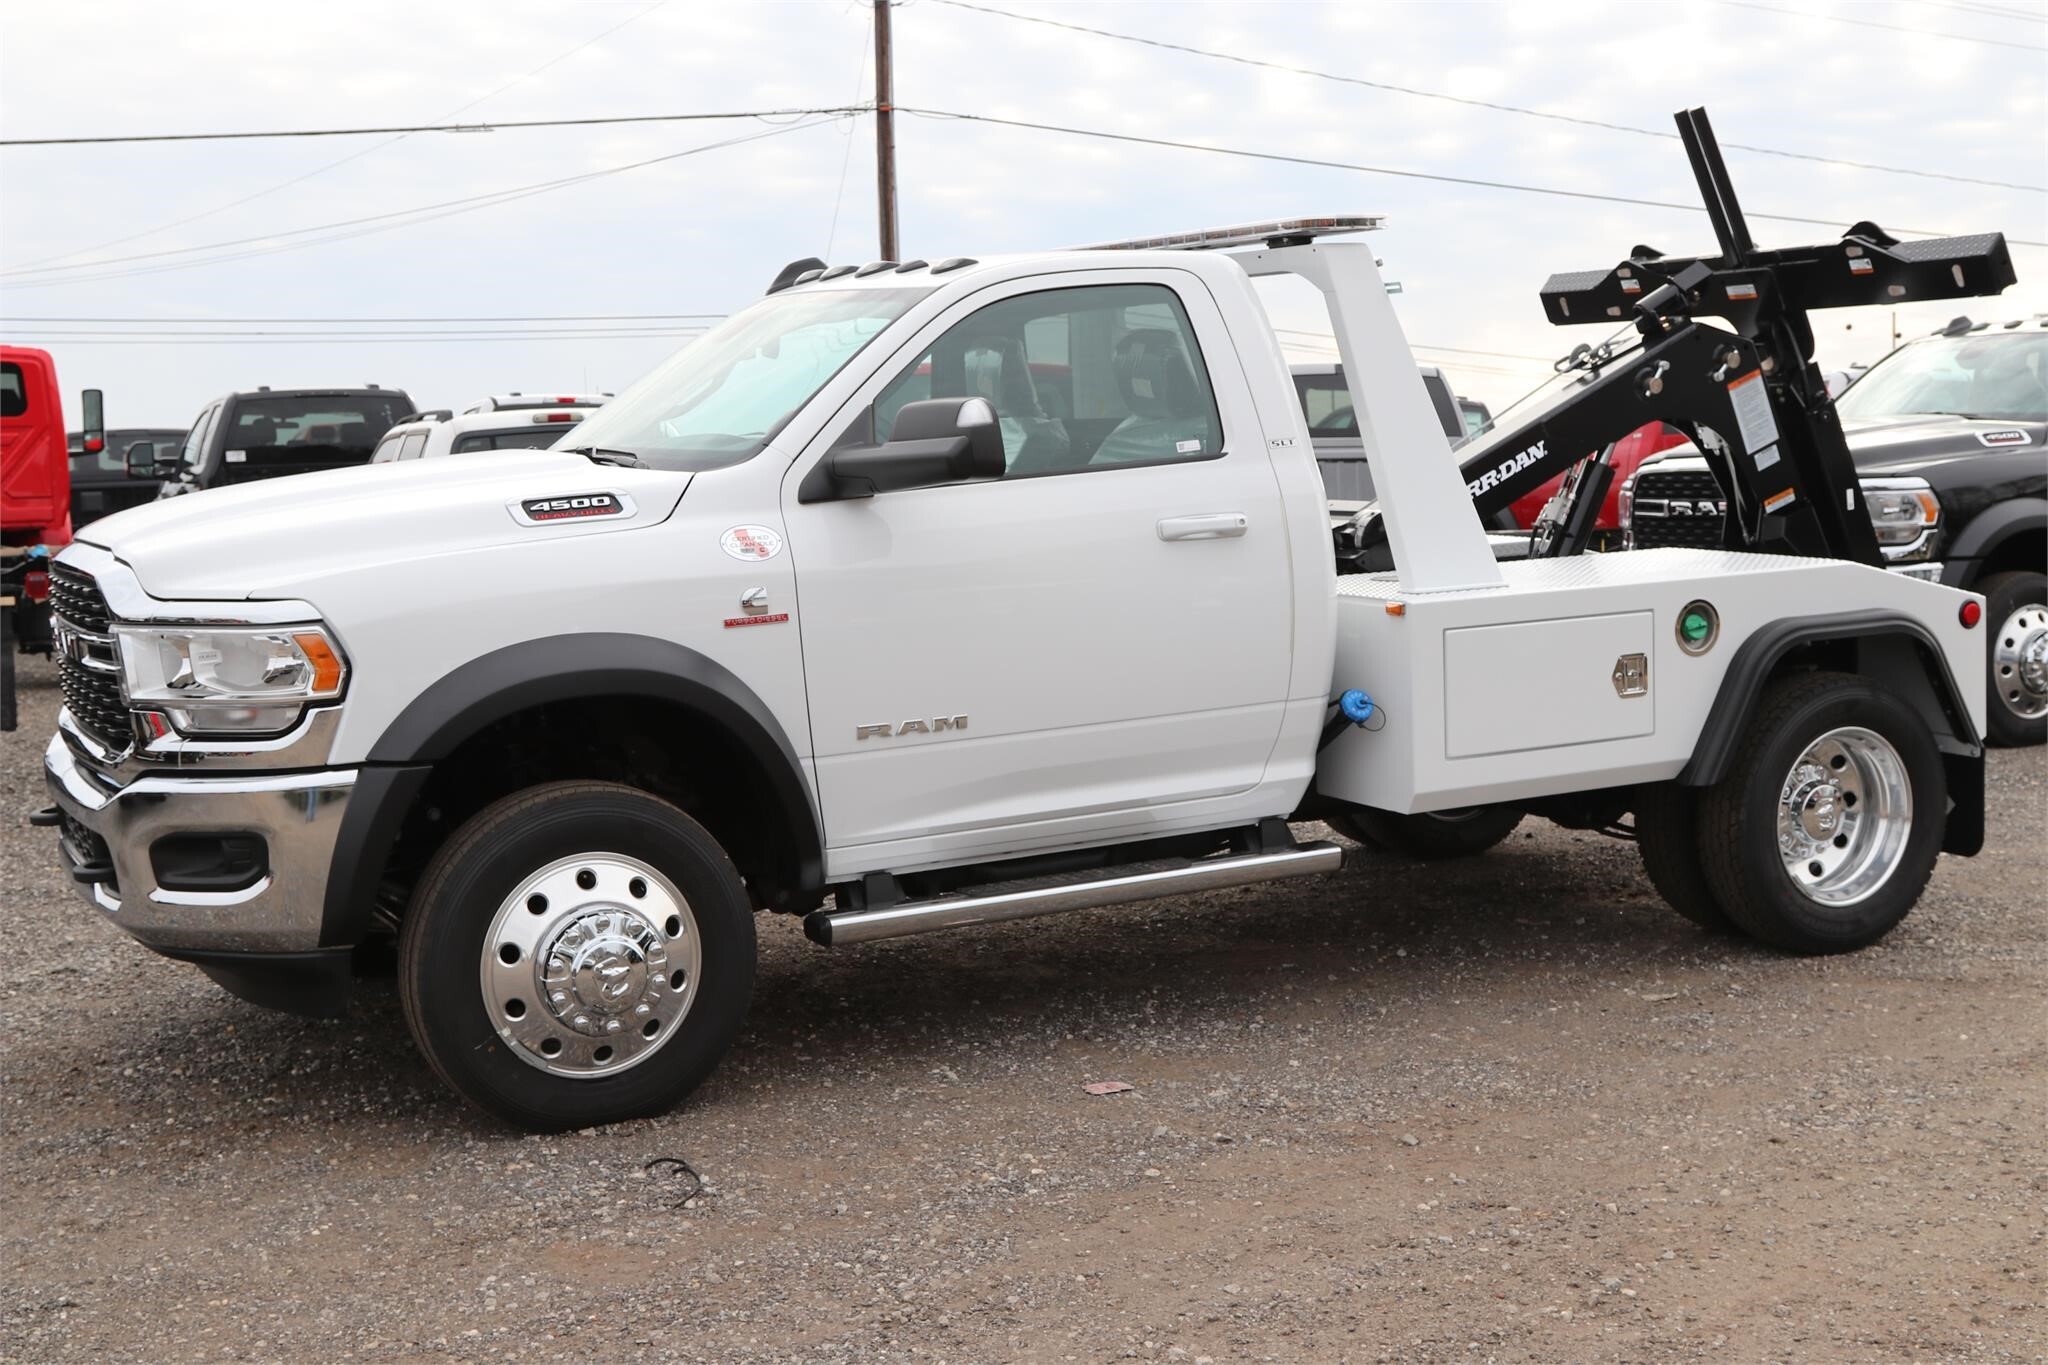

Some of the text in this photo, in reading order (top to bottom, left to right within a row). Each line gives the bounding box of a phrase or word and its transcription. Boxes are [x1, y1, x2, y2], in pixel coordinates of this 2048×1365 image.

[1271, 439, 1295, 447] SLT
[530, 496, 611, 511] 4500
[726, 614, 787, 625] TURBO DIESEL
[857, 714, 968, 740] RAM
